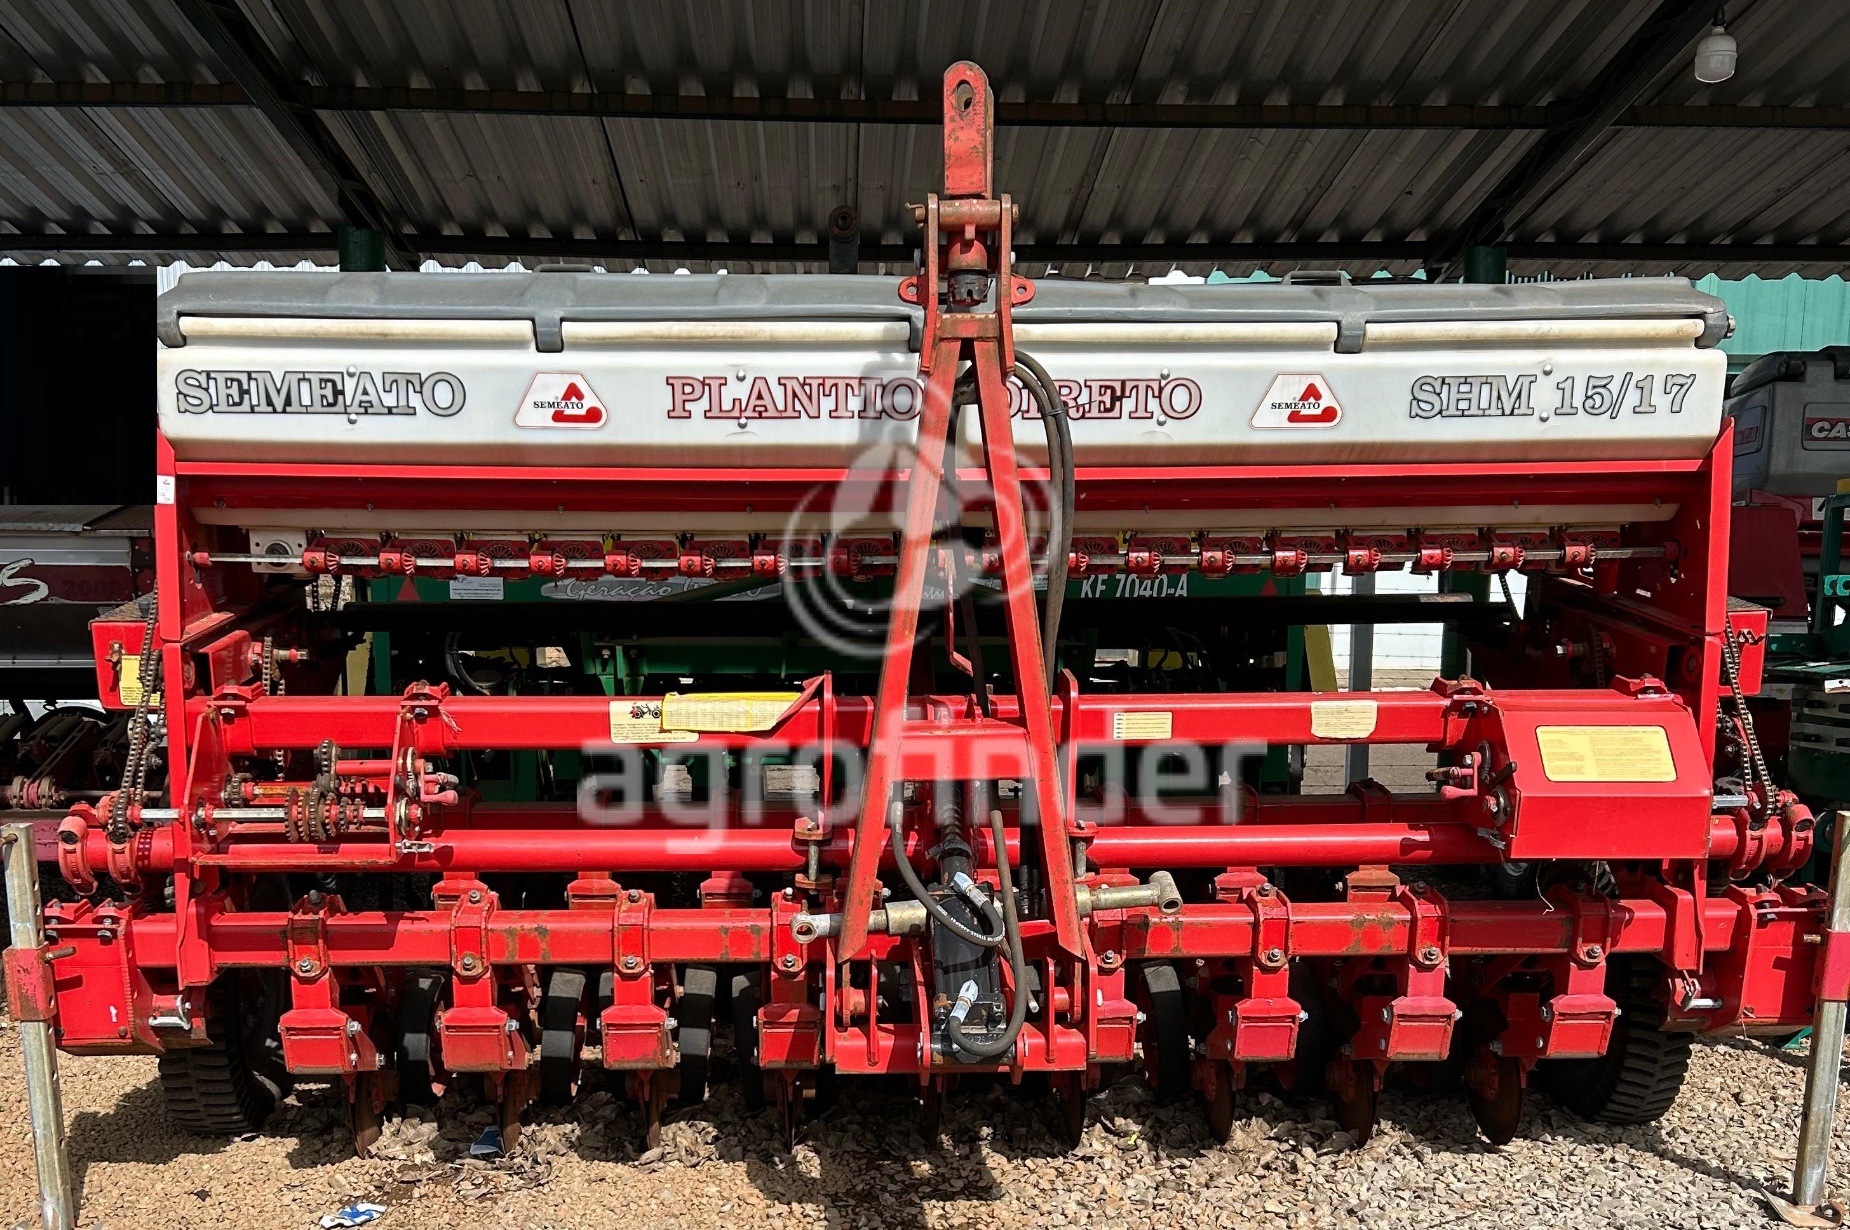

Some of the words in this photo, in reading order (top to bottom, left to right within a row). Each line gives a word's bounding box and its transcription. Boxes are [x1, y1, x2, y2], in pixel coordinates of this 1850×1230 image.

[175, 369, 466, 417] SEMEATO
[533, 401, 584, 410] SEMEATO
[666, 376, 924, 421] PLANTIO
[1271, 401, 1320, 410] SEMEATO
[1409, 374, 1537, 419] SHM
[1555, 371, 1697, 419] 15/17
[1081, 574, 1109, 598] KF
[1115, 573, 1188, 598] 7040-A
